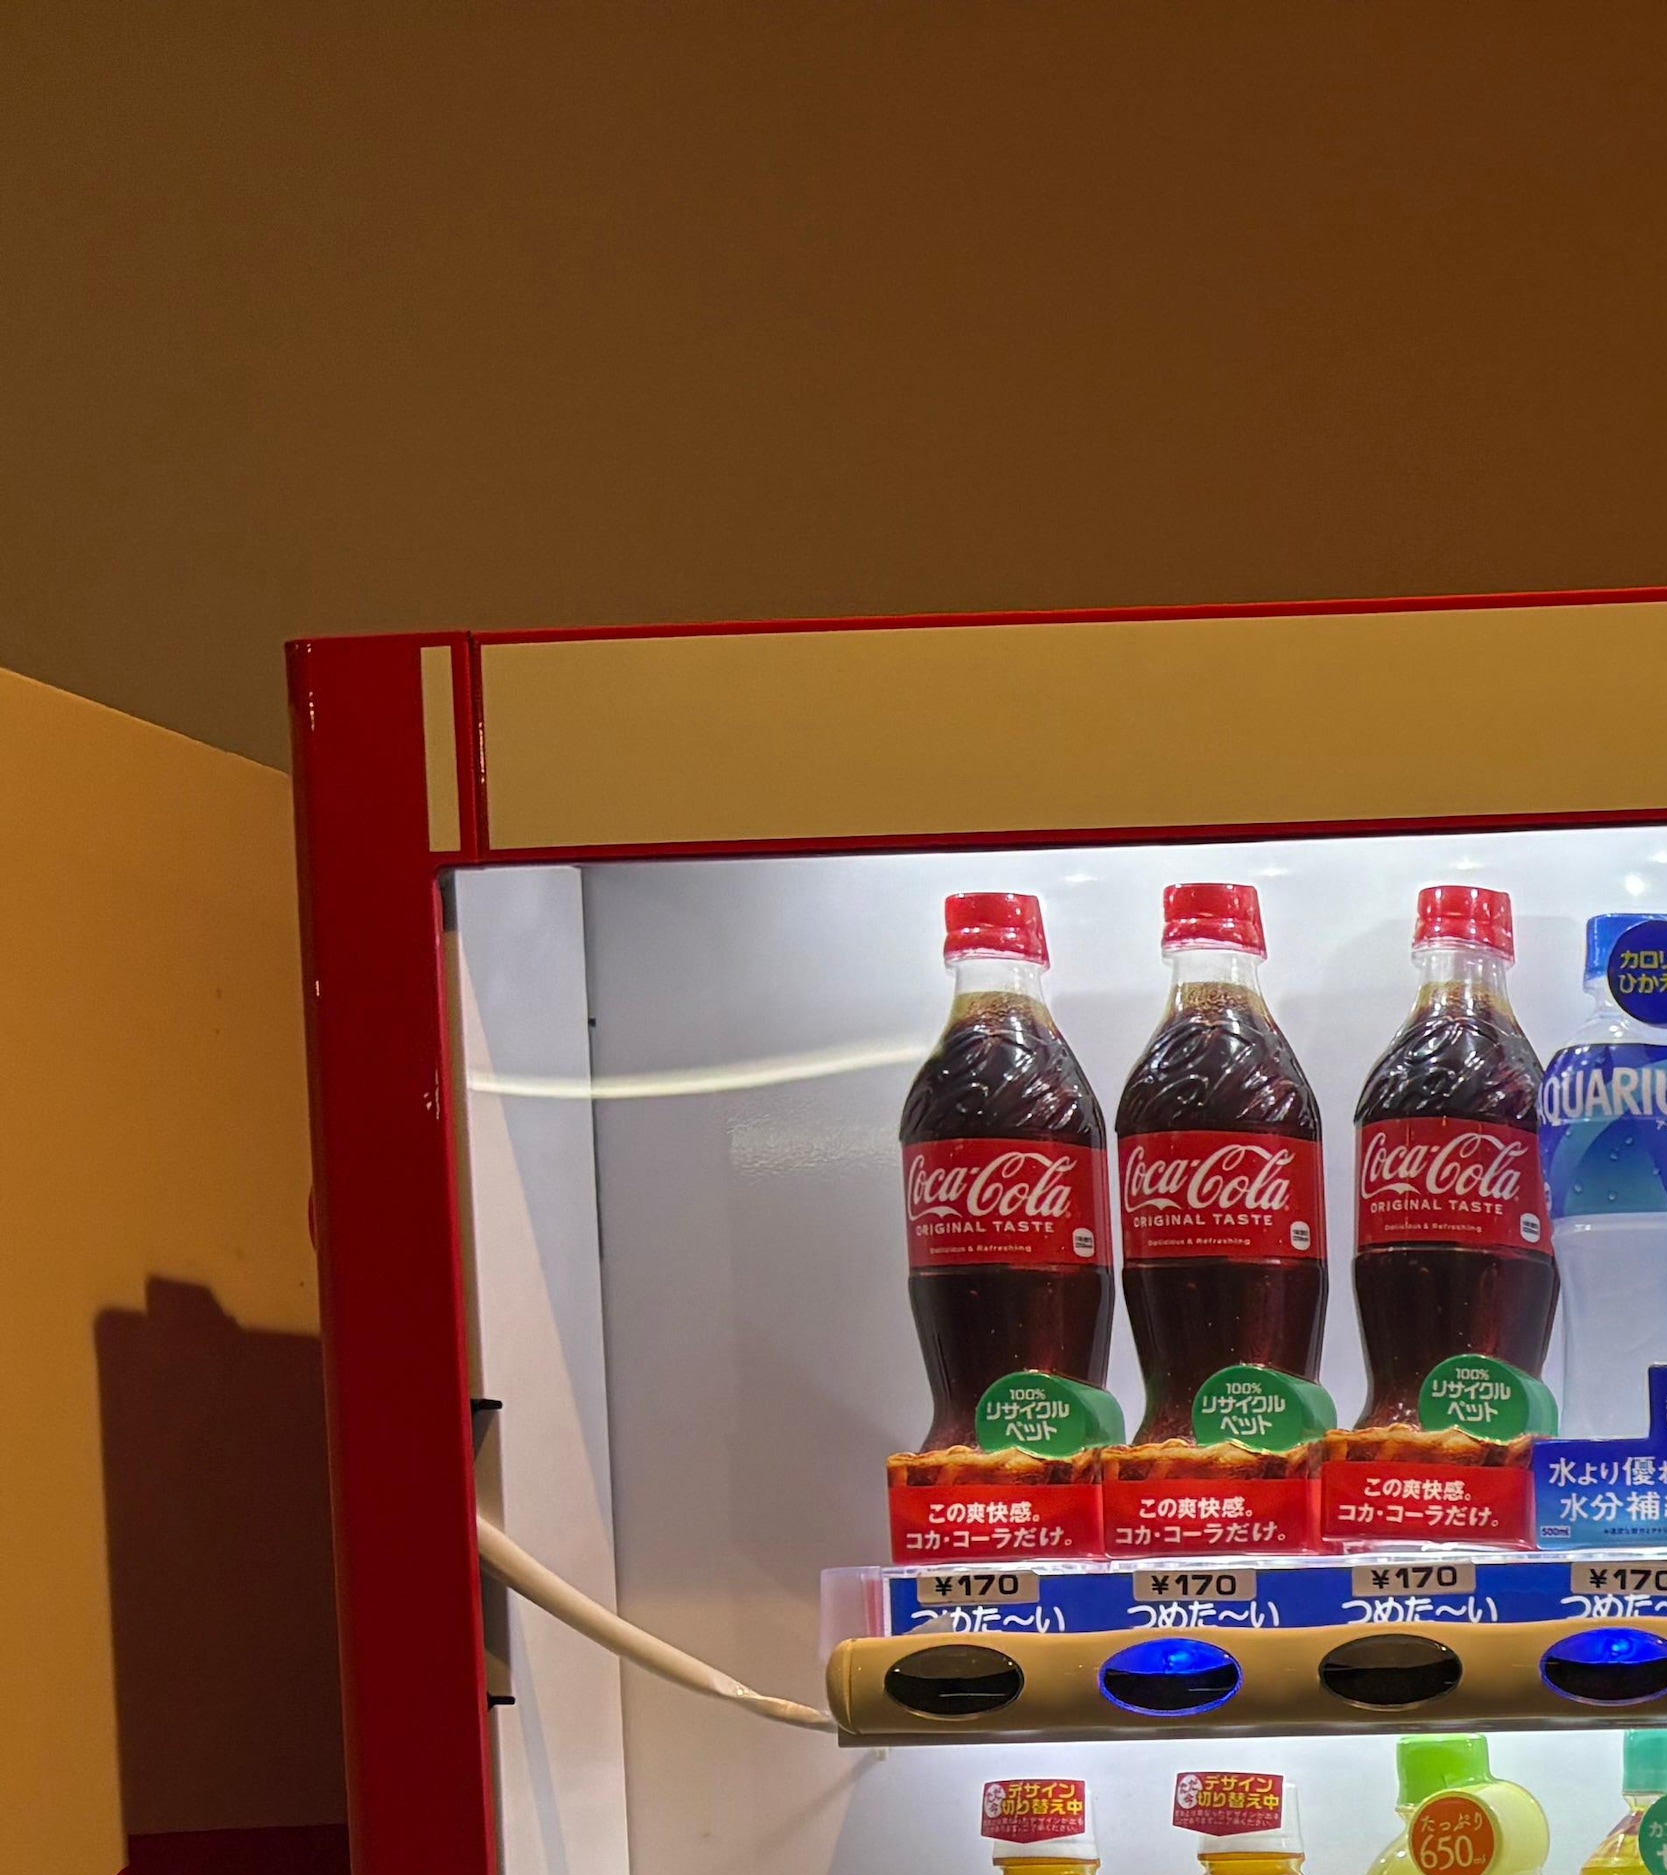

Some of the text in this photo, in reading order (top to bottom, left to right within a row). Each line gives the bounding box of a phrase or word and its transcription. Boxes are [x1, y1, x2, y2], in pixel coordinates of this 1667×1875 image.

[907, 1151, 1077, 1219] Coca-Cola
[1124, 1141, 1296, 1214] Coca-Cola
[915, 1220, 1054, 1236] ORIGINAL TASTE
[1009, 1388, 1046, 1401] 100%
[985, 1398, 1070, 1422] リサイクル
[1005, 1420, 1058, 1442] ペット
[927, 1502, 1042, 1525] この爽快感。
[906, 1527, 1074, 1550] コカ・コーラだけ。
[934, 1574, 1019, 1597] ¥170
[1151, 1574, 1238, 1596] ¥170
[1371, 1566, 1458, 1589] ¥170
[1007, 1781, 1076, 1799] デザイン
[1003, 1798, 1083, 1816] 切り替え中
